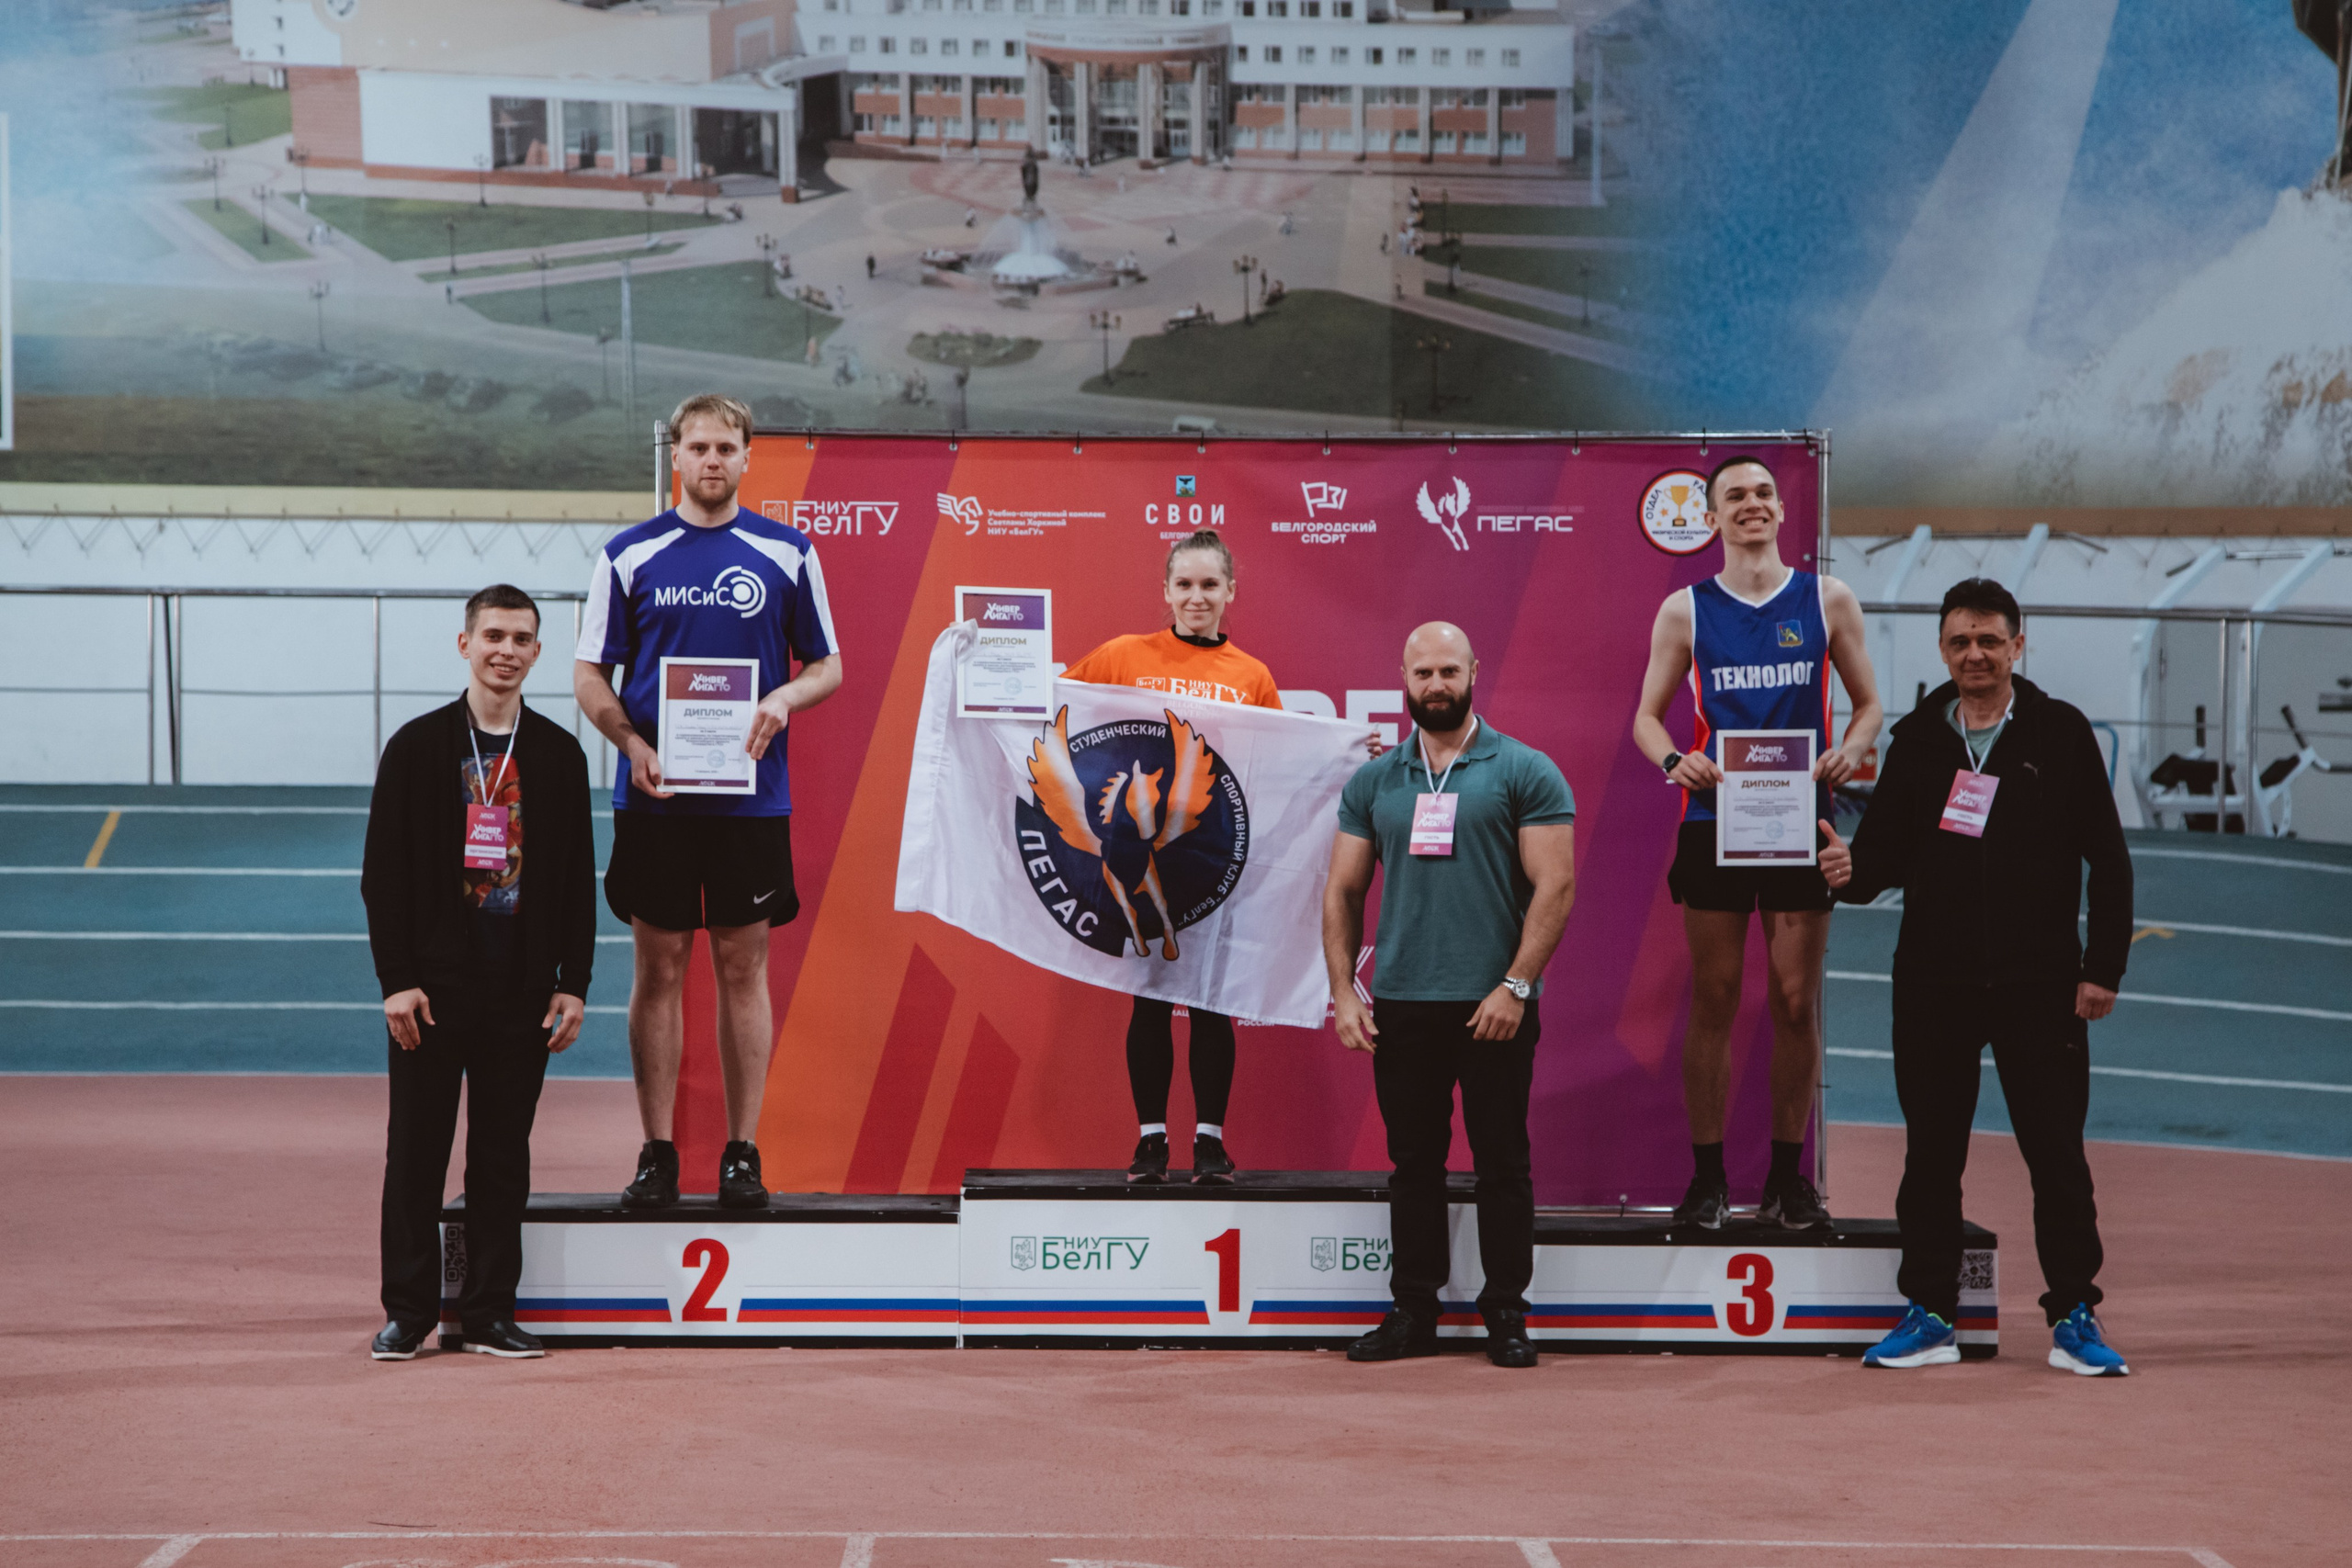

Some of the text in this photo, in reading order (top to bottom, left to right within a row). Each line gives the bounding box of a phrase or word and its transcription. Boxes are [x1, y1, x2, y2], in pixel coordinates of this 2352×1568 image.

[814, 501, 851, 514] НИУ
[1645, 489, 1662, 520] ОТДЕЛ
[793, 506, 899, 536] БелГУ
[988, 518, 1067, 527] Светланы Хоркиной
[988, 527, 1007, 536] НИУ
[1272, 520, 1377, 532] БЕЛГОРОДСКИЙ
[1476, 515, 1574, 532] ПЕГАС
[1301, 534, 1347, 544] СПОРТ
[655, 586, 730, 607] МИСиС
[979, 637, 1027, 646] ДИПЛОМ
[1189, 680, 1213, 689] НИУ
[1711, 661, 1814, 692] ТЕХНОЛОГ
[684, 708, 732, 717] ДИПЛОМ
[1069, 724, 1167, 753] СТУДЕНЧЕСКИЙ
[1741, 780, 1790, 789] ДИПЛОМ
[1220, 774, 1246, 862] СПОРТИВНЫЙ
[1021, 829, 1099, 937] ПЕГАС
[1217, 863, 1239, 895] КЛУБ
[1064, 1237, 1102, 1249] НИУ
[1043, 1242, 1149, 1269] БелГУ
[682, 1238, 729, 1321] 2
[1204, 1229, 1240, 1312] 1
[1726, 1253, 1774, 1336] 3
